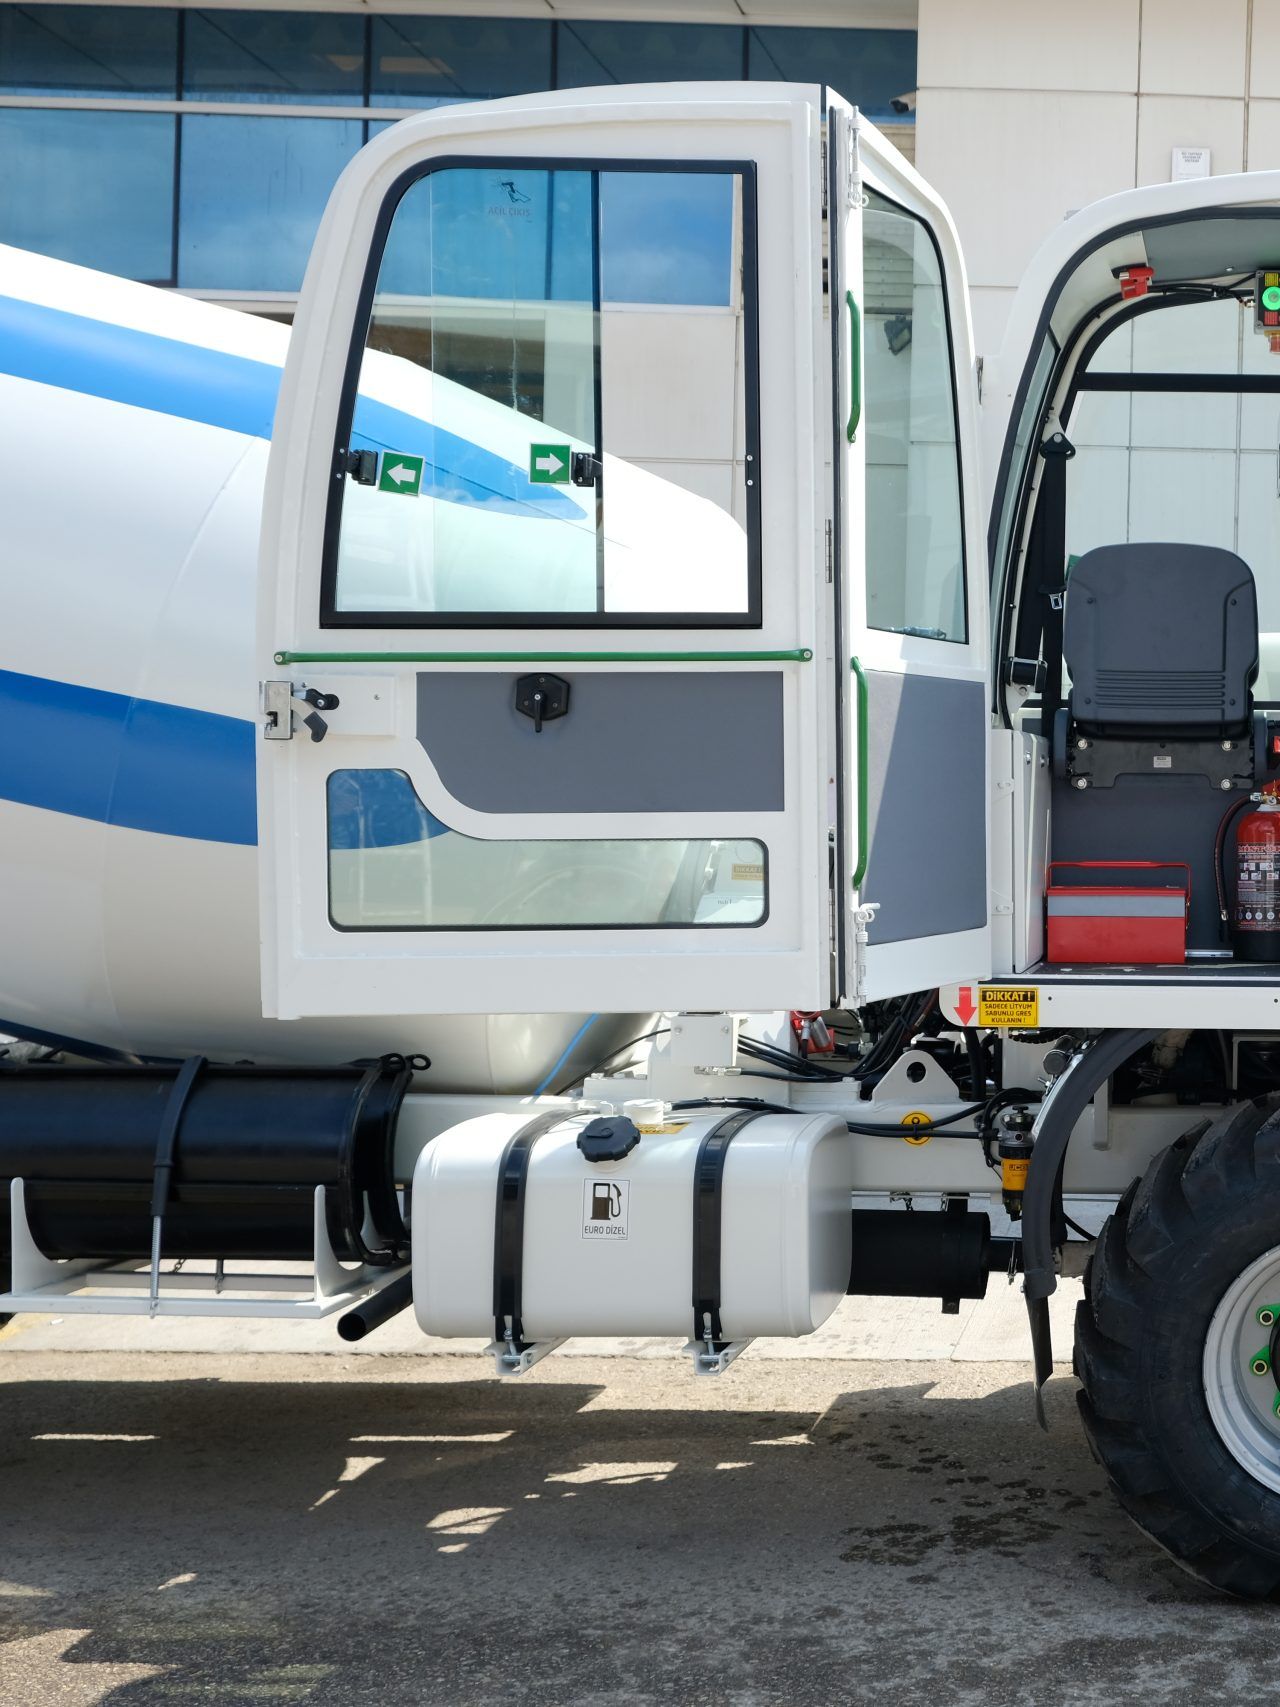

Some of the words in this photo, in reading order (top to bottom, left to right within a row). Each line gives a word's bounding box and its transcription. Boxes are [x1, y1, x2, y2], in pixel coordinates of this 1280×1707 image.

[986, 991, 1025, 1001] DİKKAT
[1009, 1002, 1032, 1010] LİTYUM
[584, 1225, 604, 1234] EURO
